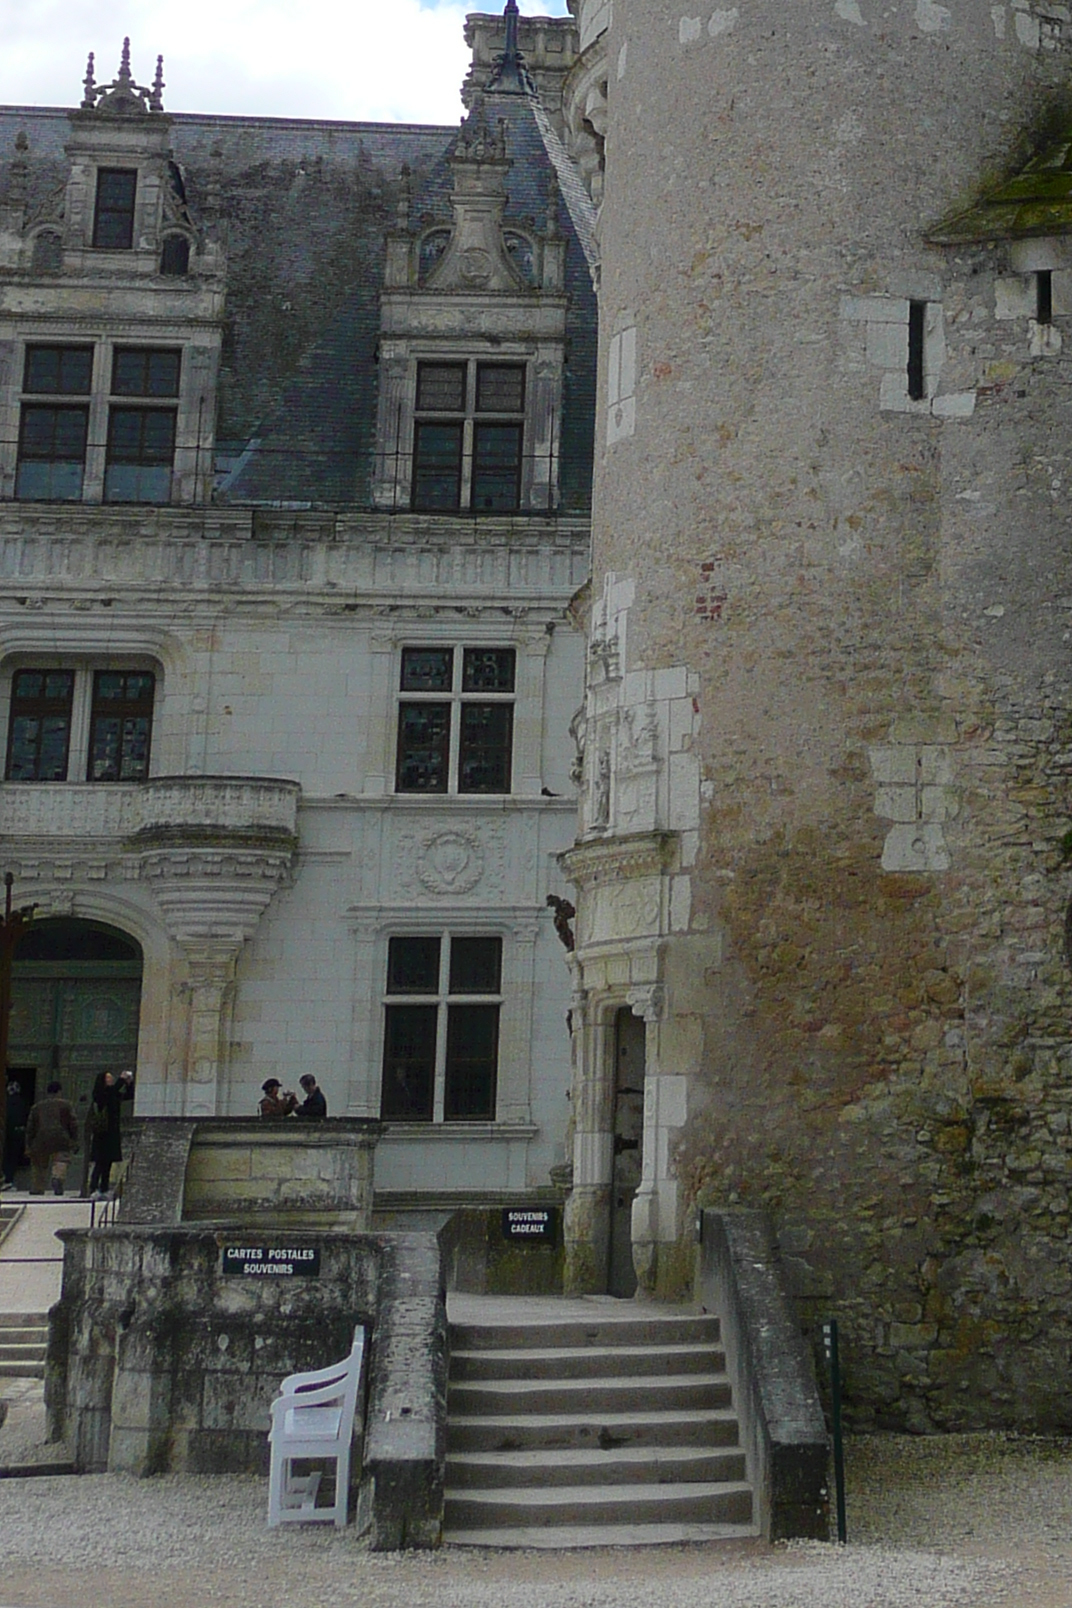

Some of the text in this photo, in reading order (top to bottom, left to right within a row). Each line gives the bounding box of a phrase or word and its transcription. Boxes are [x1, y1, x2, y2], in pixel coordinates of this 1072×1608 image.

[508, 1212, 548, 1221] SOUVENIRS
[511, 1224, 544, 1233] CADEAUX
[227, 1249, 315, 1260] CARTES POSTALES
[243, 1264, 293, 1274] SOUVENIRS
